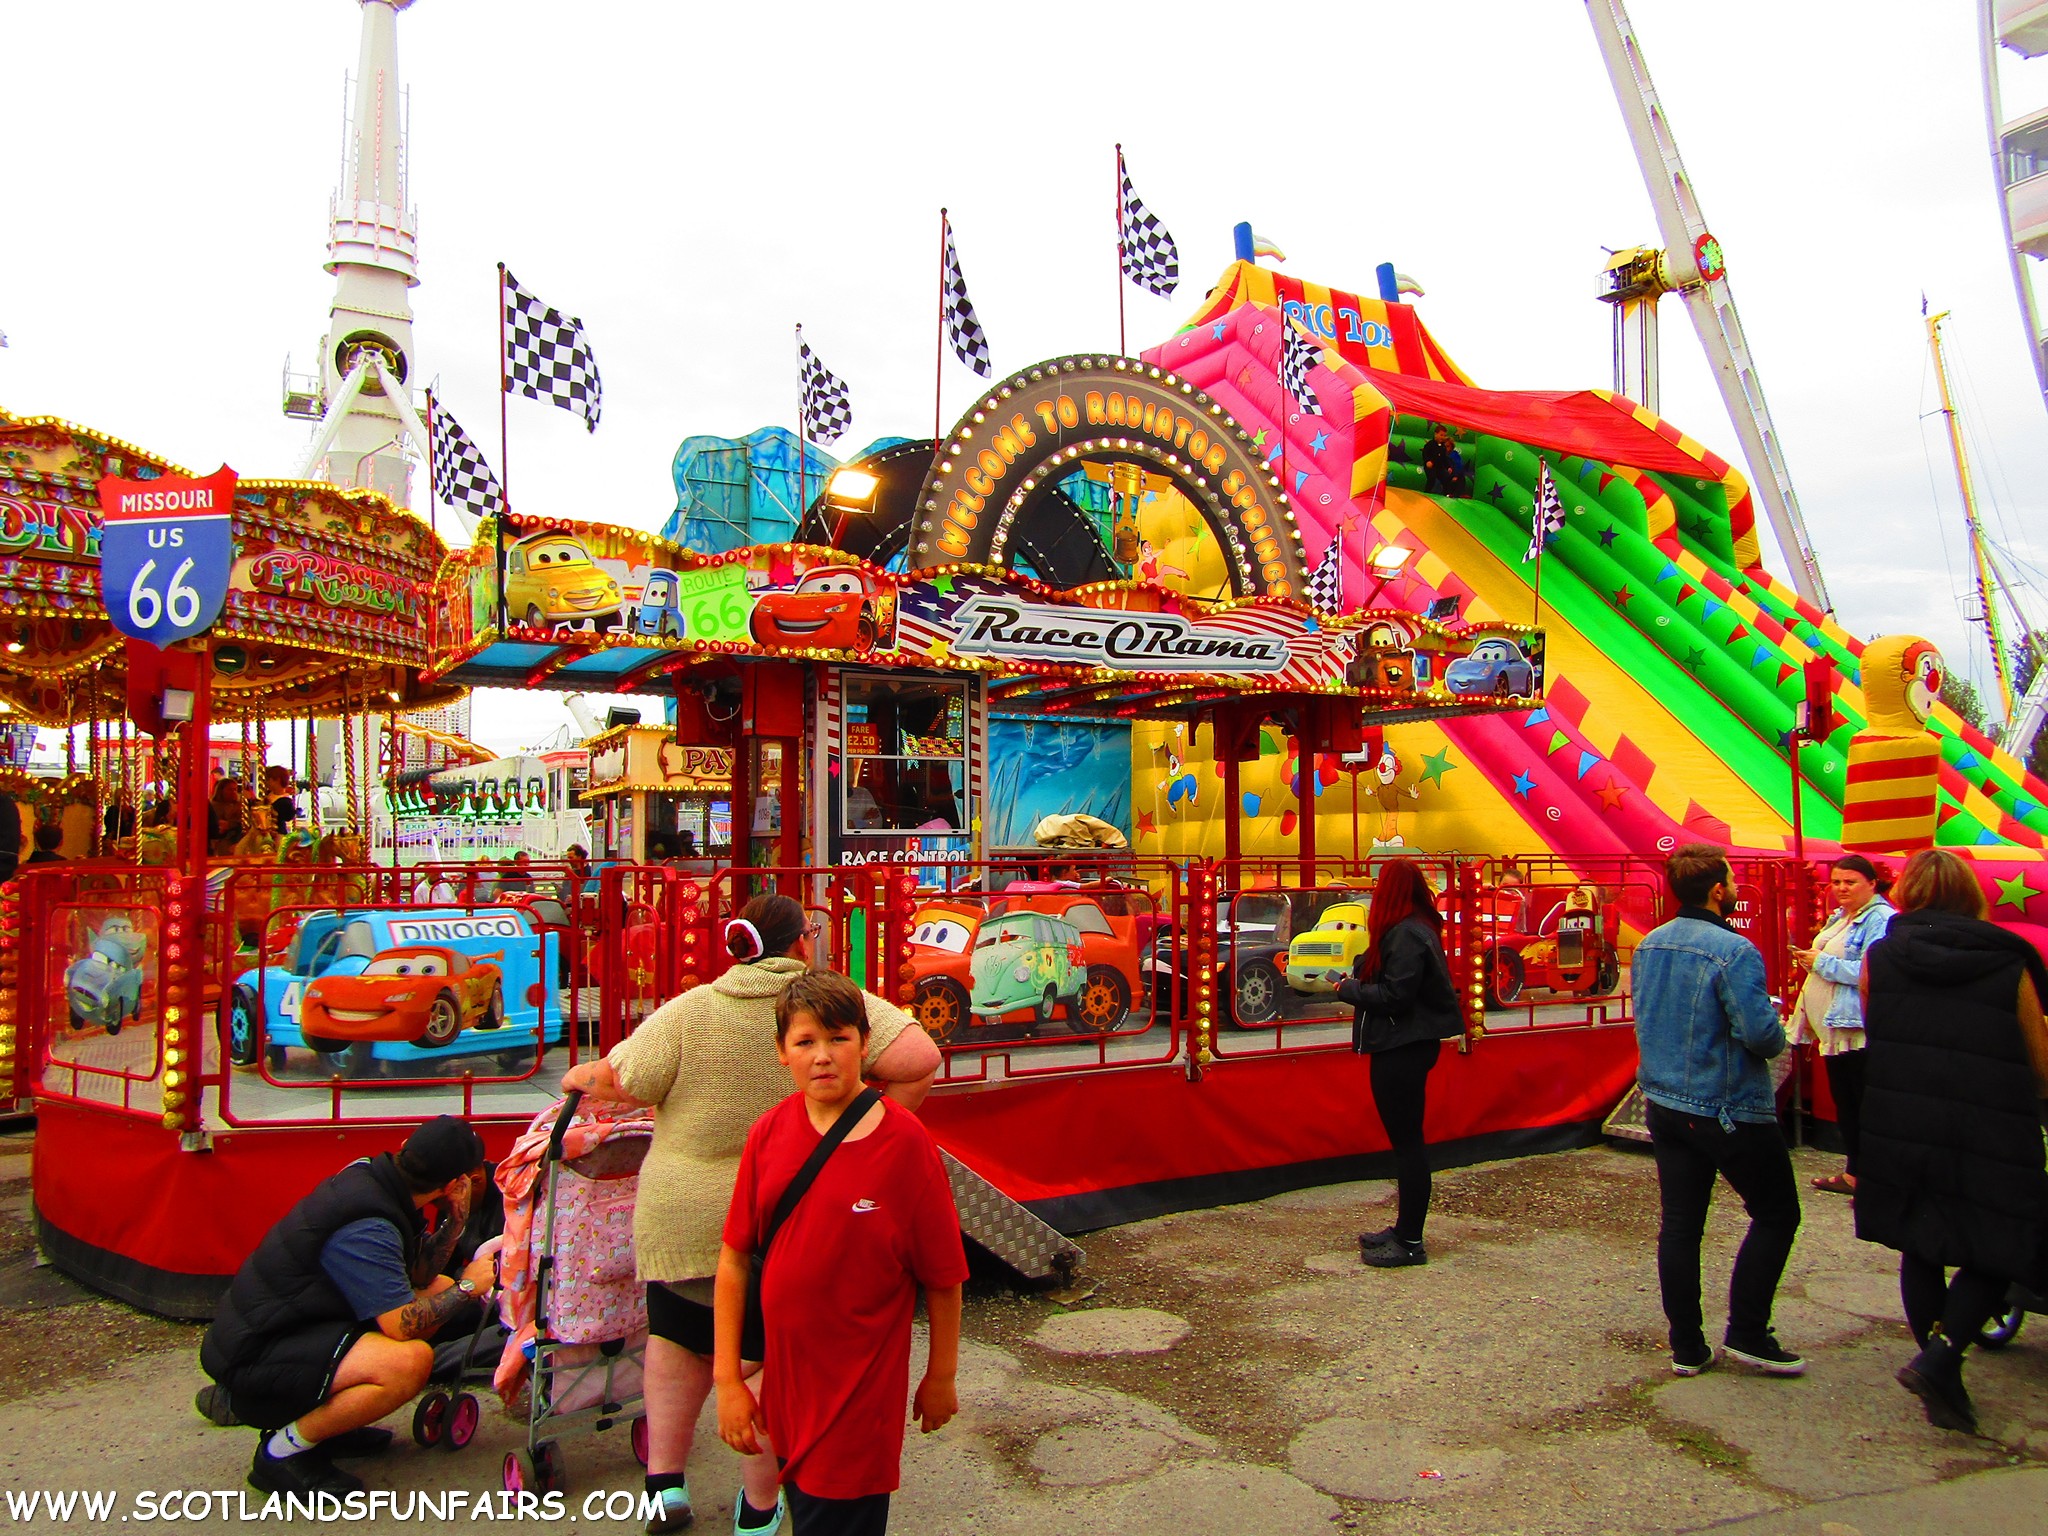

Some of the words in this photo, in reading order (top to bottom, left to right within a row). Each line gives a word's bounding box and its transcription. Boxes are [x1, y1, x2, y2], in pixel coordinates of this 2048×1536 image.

[1283, 300, 1337, 339] BIG
[121, 489, 214, 513] MISSOURI
[937, 412, 1036, 558] WELCOME
[1034, 395, 1079, 434] TO
[1085, 391, 1227, 475] RADIATOR
[1222, 469, 1292, 598] SPRINGS
[990, 486, 1028, 559] LIGHTYER
[148, 527, 184, 549] US
[129, 557, 200, 629] 66
[684, 569, 733, 593] ROUTE
[692, 592, 746, 637] 66
[851, 725, 870, 734] FARE
[841, 850, 889, 866] RACE
[893, 850, 968, 863] CONTROL
[1734, 901, 1748, 912] XIT
[400, 920, 516, 941] DINOCO
[1725, 917, 1751, 929] ONLY
